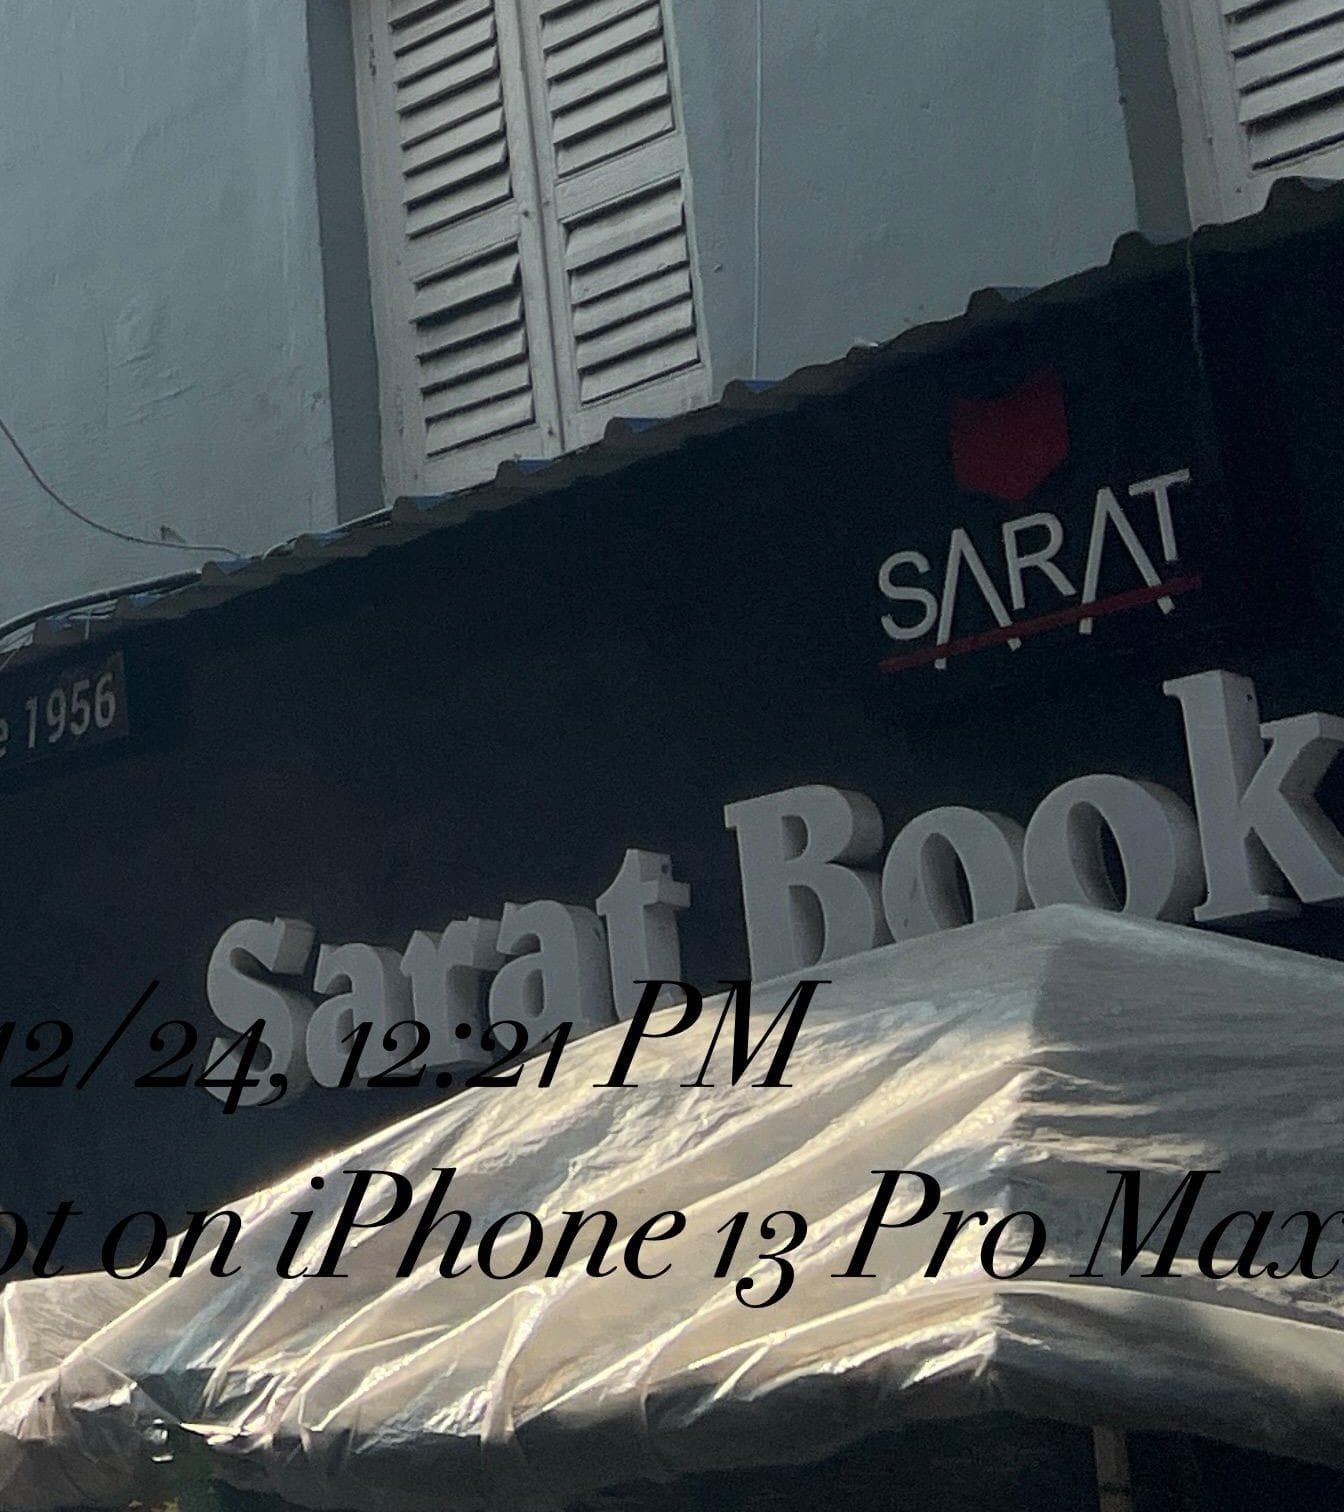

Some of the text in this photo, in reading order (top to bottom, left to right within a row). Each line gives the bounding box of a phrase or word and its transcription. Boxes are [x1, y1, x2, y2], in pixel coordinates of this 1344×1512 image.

[879, 469, 1191, 670] SARAT
[24, 673, 116, 749] 1956
[206, 669, 1344, 1108] Sarat Book
